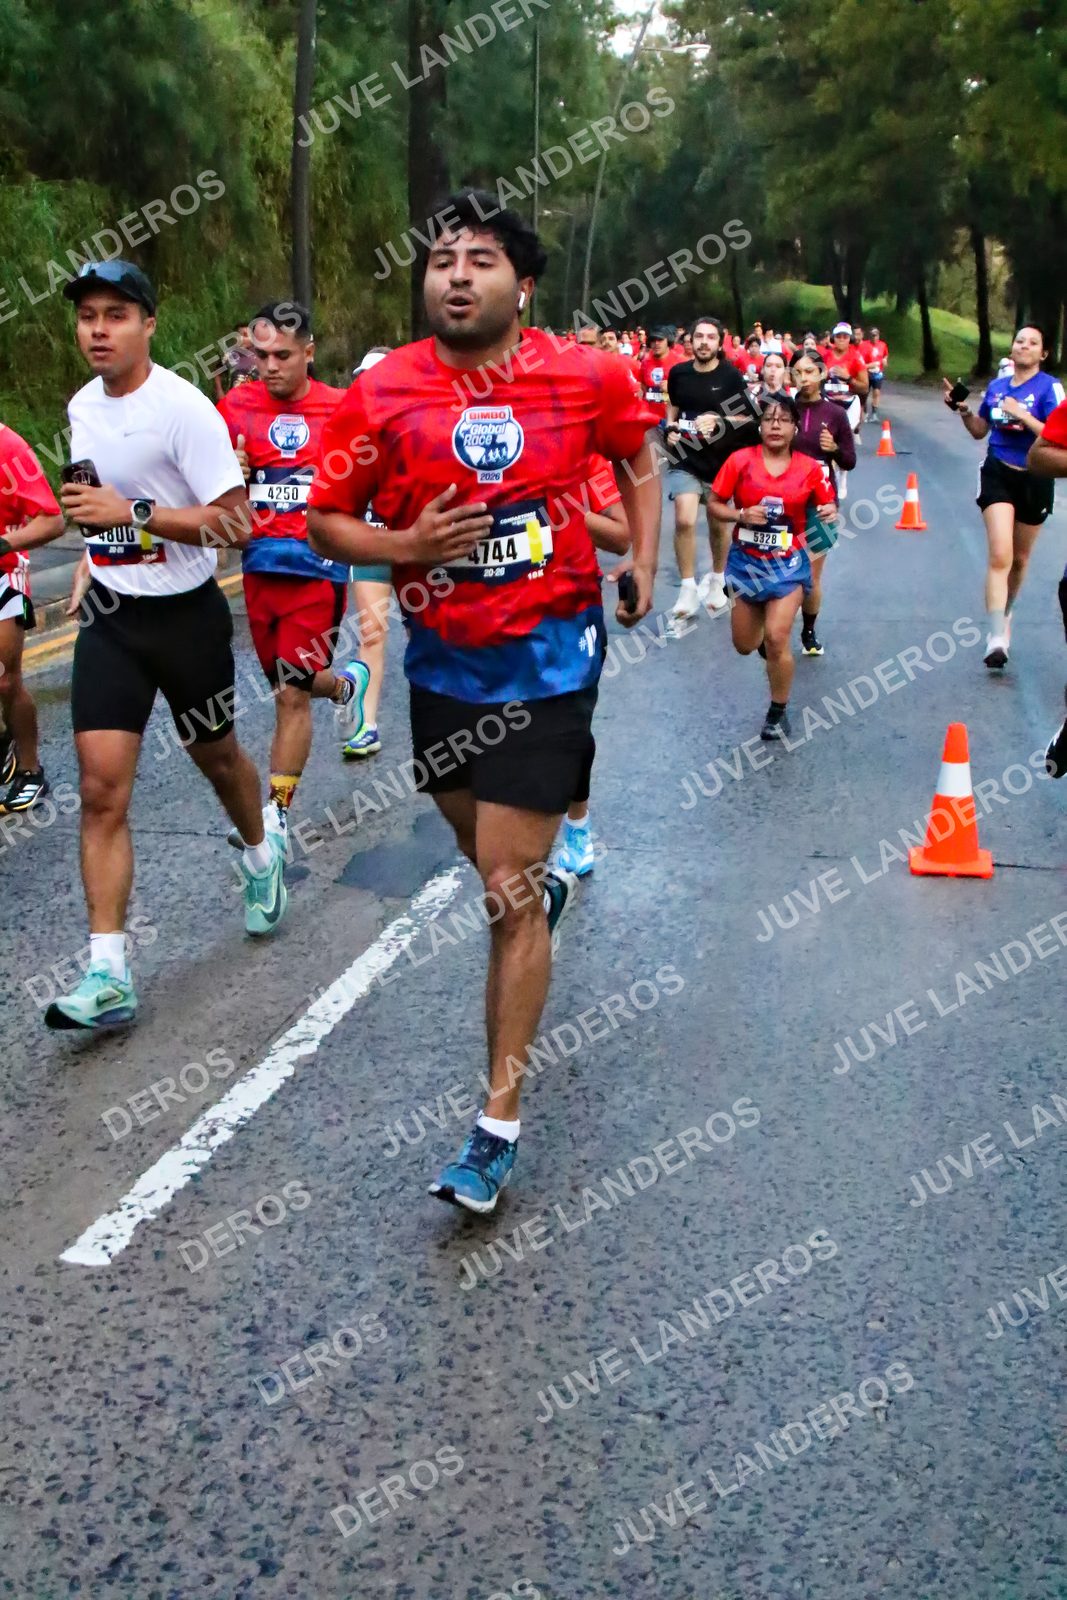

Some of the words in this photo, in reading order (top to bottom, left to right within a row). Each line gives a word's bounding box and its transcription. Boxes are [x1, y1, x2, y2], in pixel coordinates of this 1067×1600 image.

[469, 411, 506, 420] BIMBO
[470, 423, 505, 434] Global
[463, 433, 492, 446] Race
[480, 472, 500, 481] 2026
[268, 487, 299, 500] 4250
[753, 531, 777, 544] 5328
[468, 537, 517, 564] 4744
